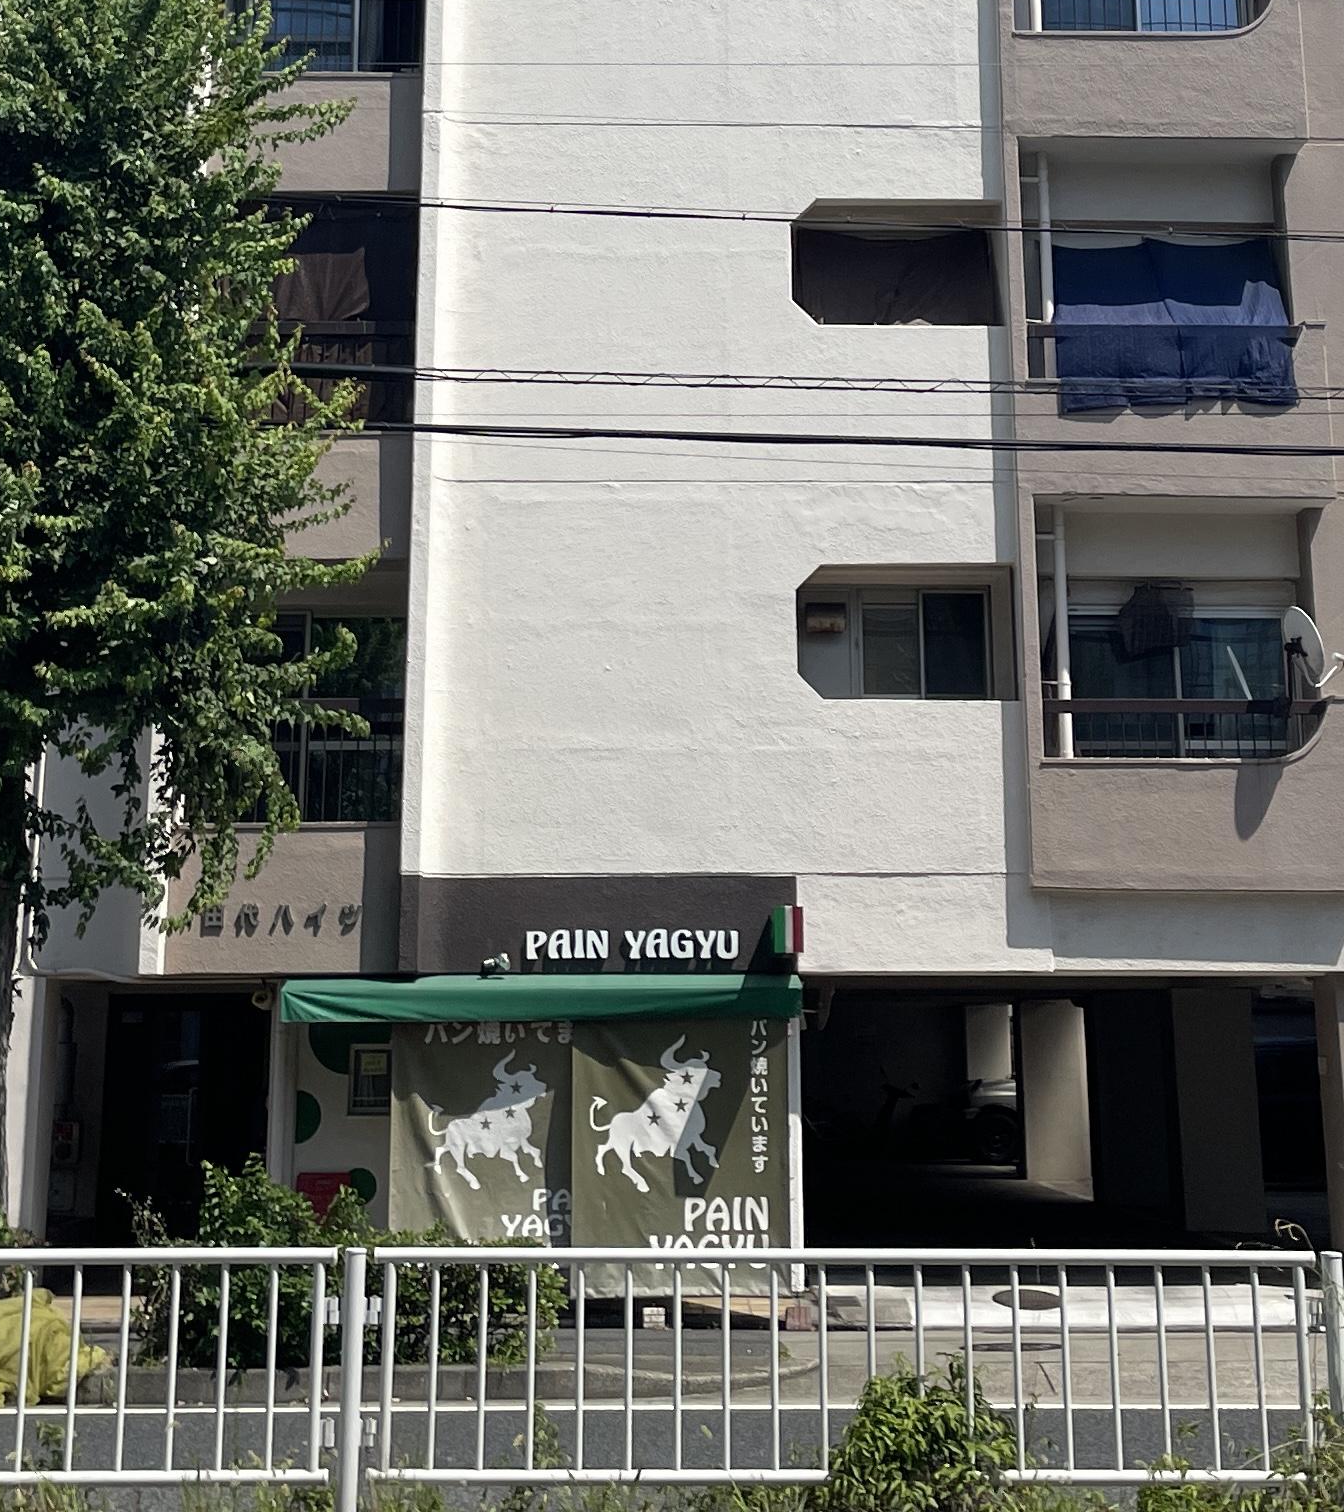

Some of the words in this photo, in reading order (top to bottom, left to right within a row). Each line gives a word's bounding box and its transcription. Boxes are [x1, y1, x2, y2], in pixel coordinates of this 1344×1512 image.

[526, 929, 609, 960] PAIN
[624, 928, 740, 960] YAGYU
[749, 1020, 770, 1174] パン焼いています
[684, 1196, 770, 1232] PAIN
